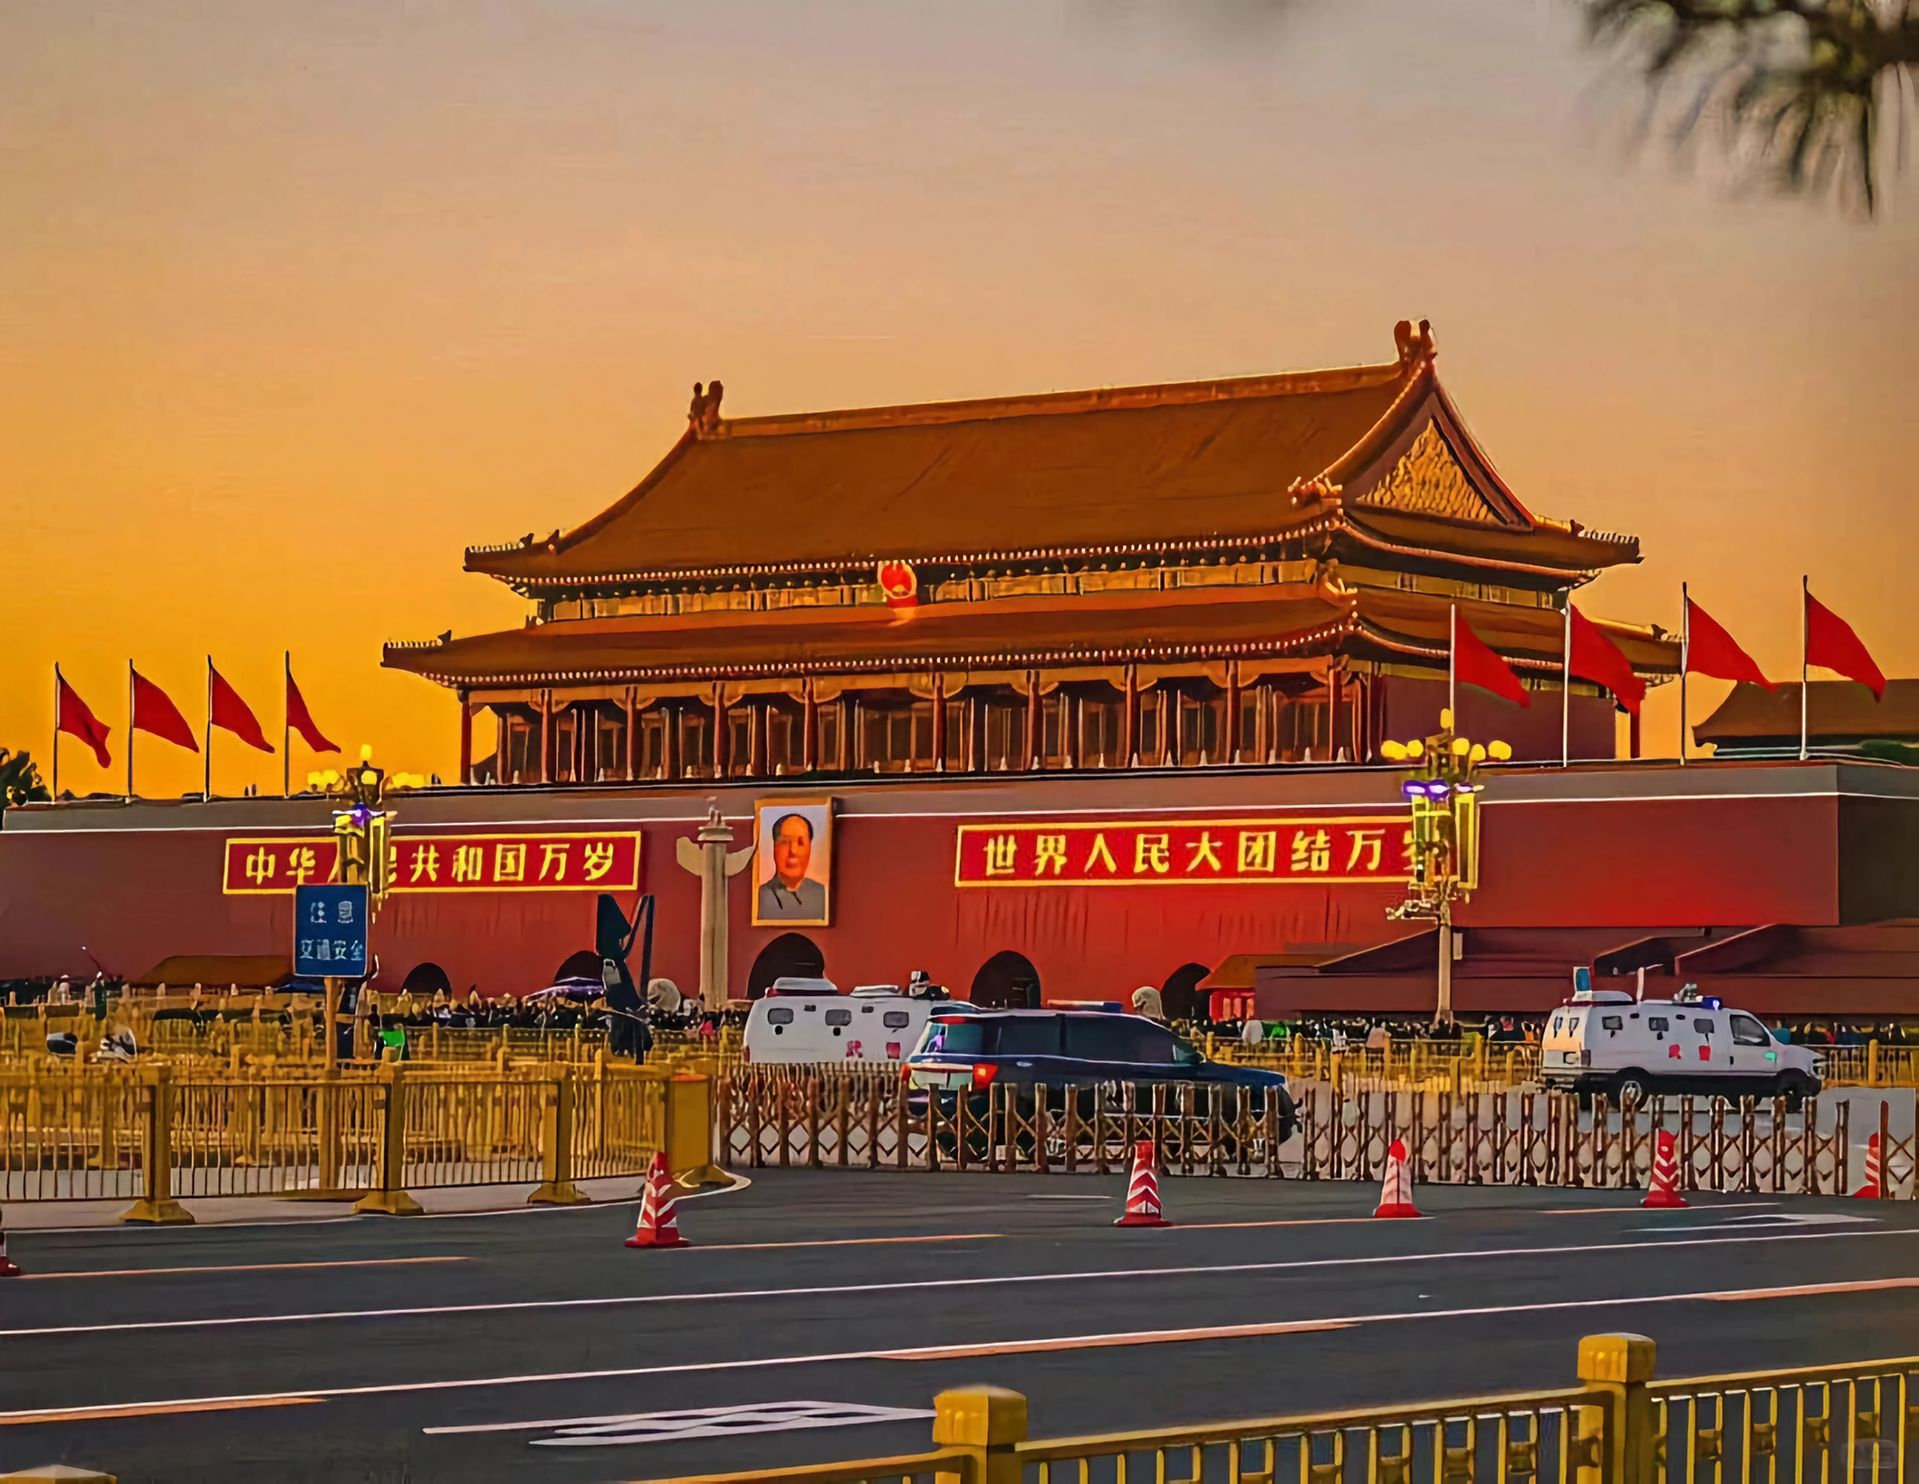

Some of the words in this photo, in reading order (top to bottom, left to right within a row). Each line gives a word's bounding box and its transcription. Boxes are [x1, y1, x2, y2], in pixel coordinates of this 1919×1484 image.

[245, 842, 614, 885] 中华共和国万岁
